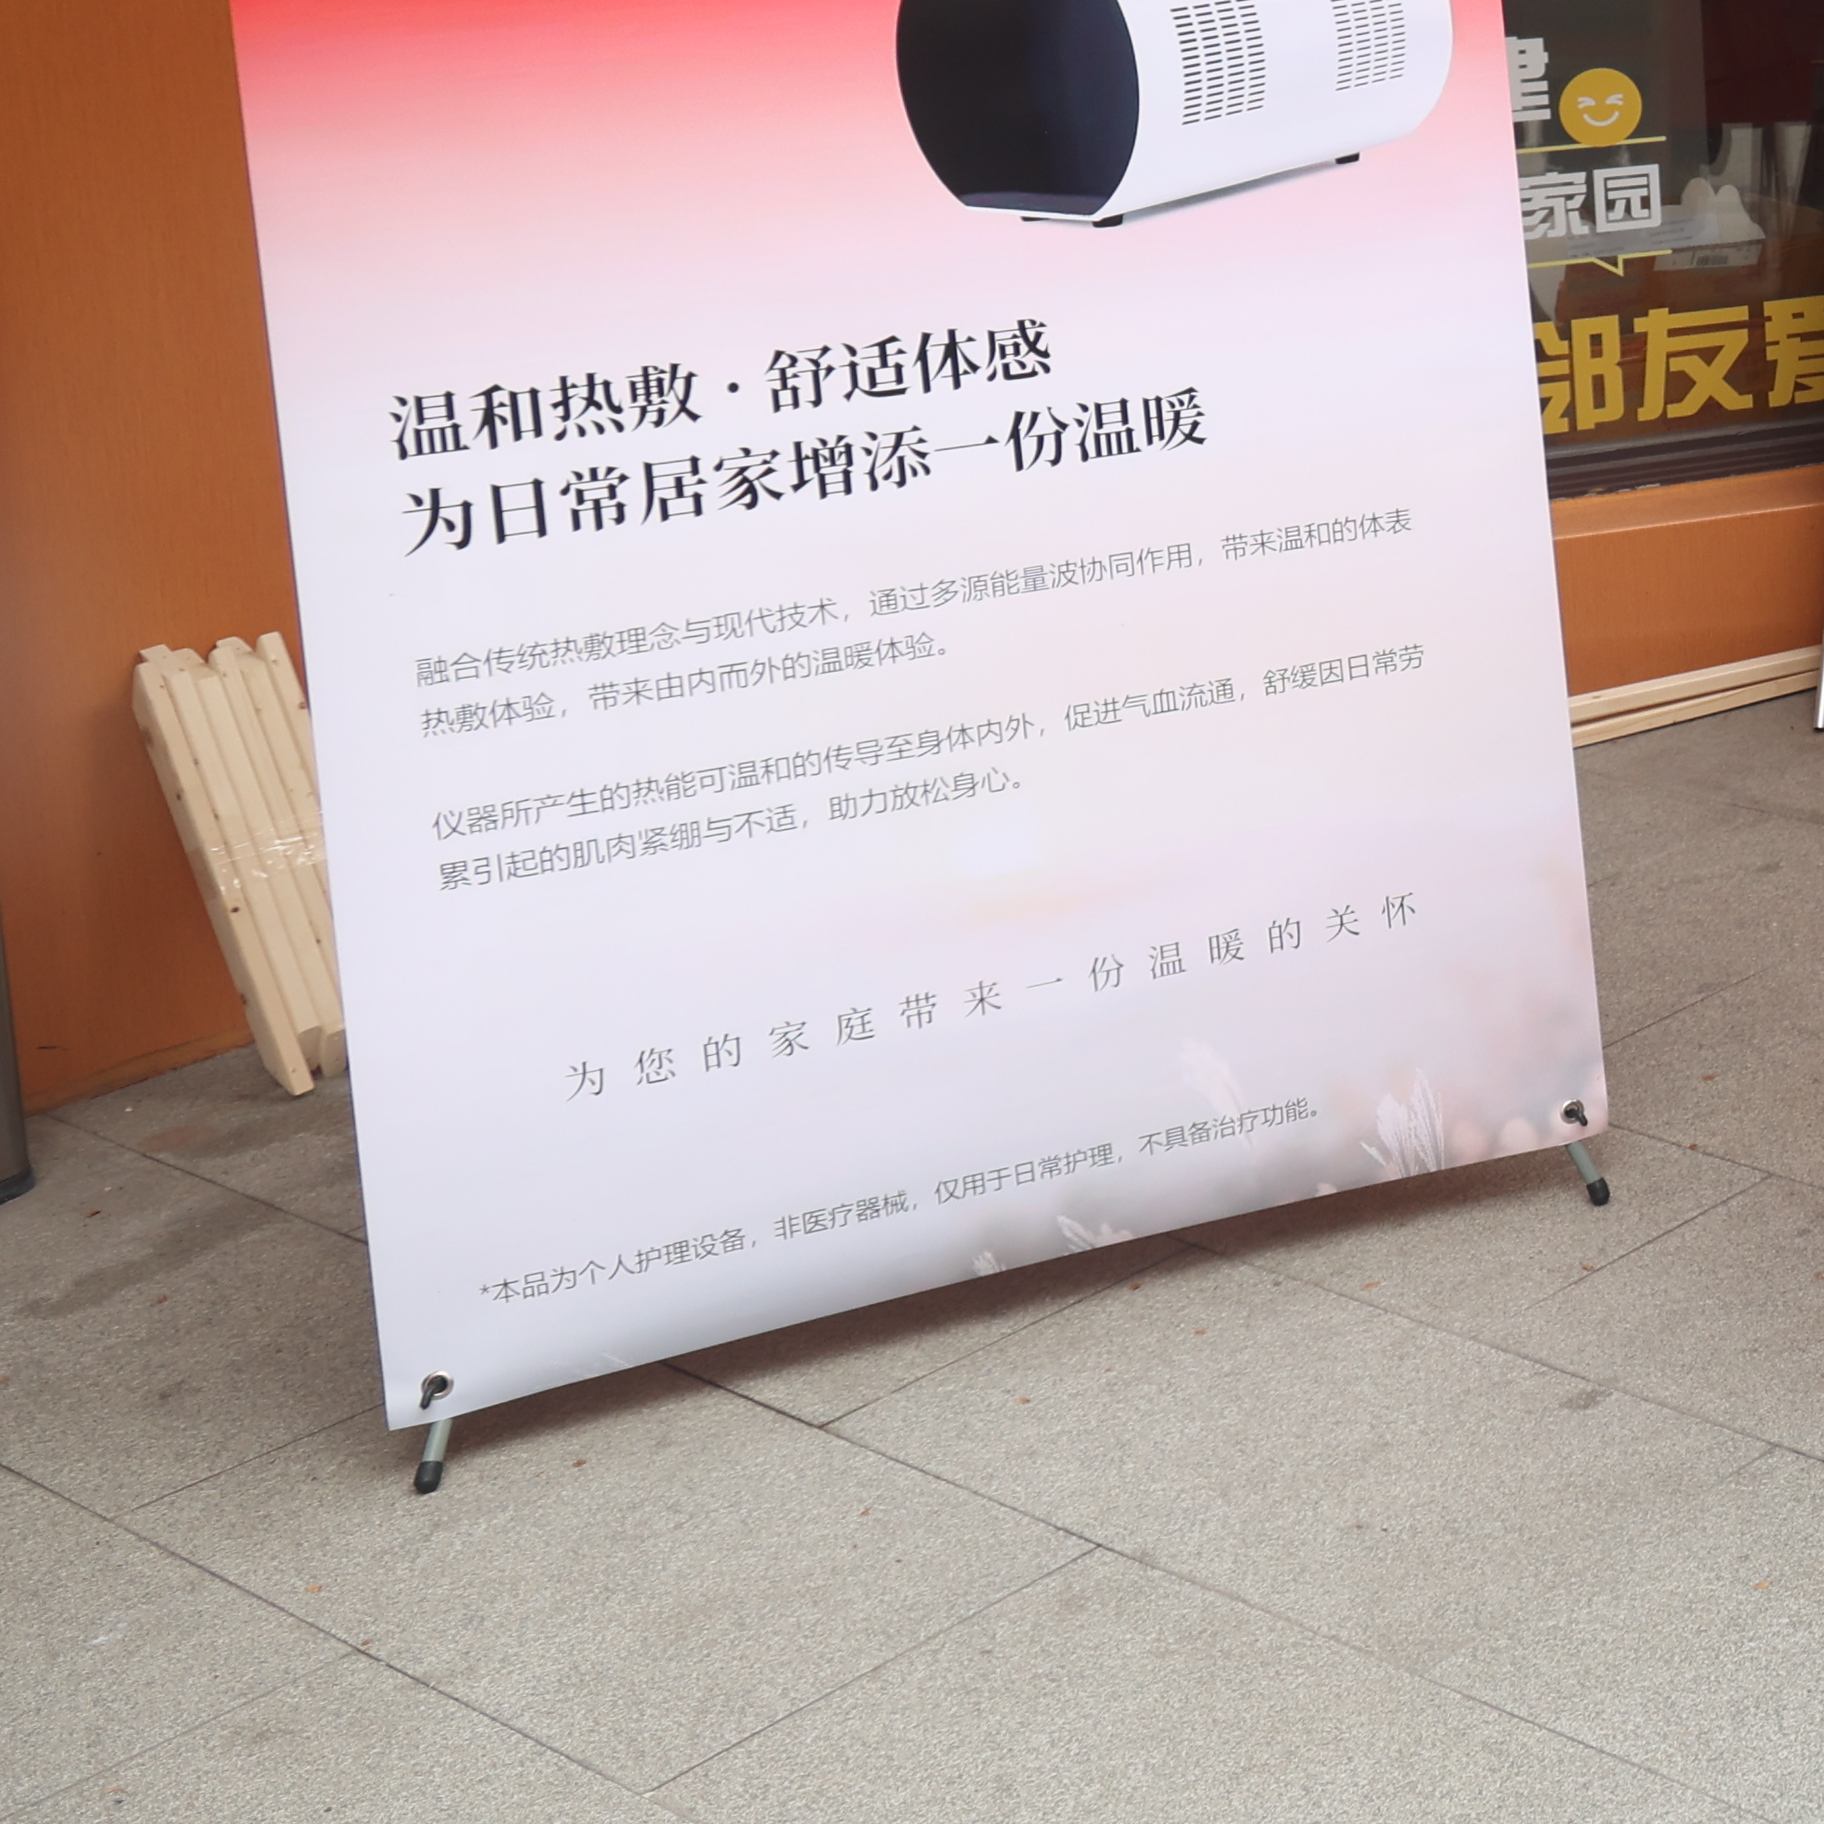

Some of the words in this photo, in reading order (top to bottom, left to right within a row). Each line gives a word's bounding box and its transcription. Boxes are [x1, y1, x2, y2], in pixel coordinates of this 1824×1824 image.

[1519, 163, 1662, 240] 家园
[401, 384, 1208, 558] 为日常居家增添一份温暖
[564, 891, 1418, 1103] 为您的家庭带来一份温暖的关怀
